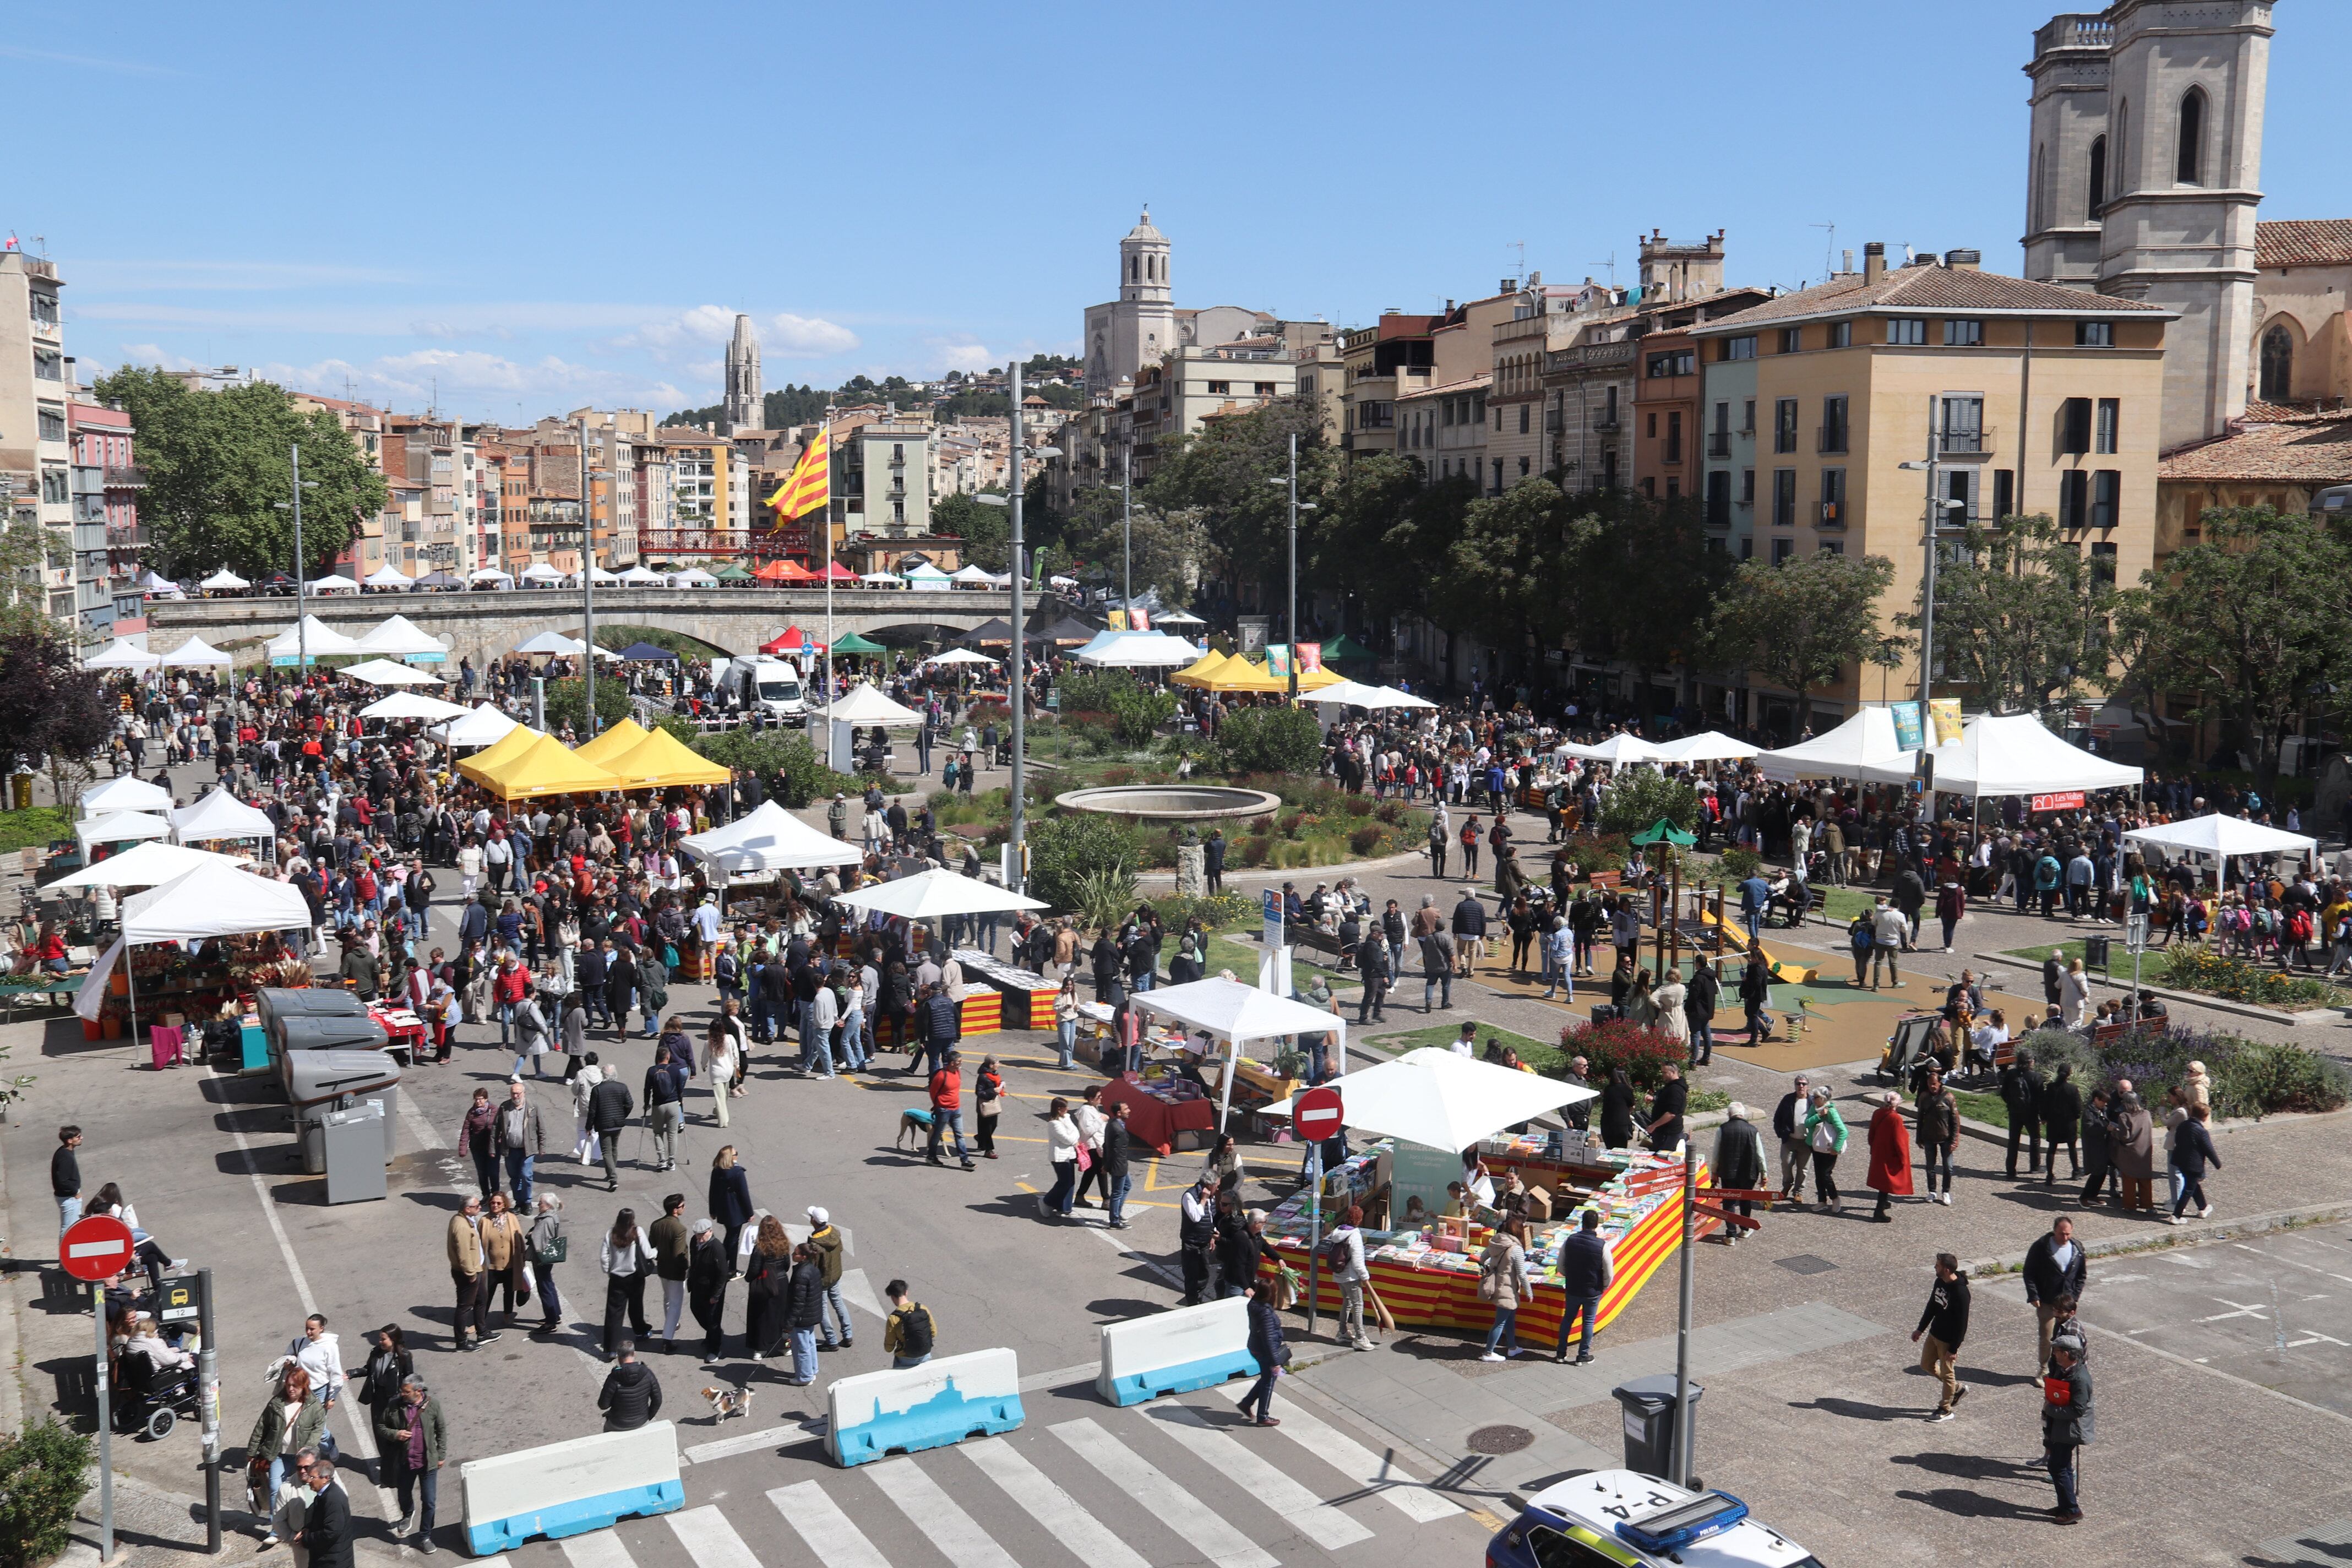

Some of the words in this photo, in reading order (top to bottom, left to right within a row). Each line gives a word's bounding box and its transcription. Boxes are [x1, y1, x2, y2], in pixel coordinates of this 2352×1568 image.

[2055, 793, 2066, 802] Les
[2066, 792, 2083, 801] Voltes
[1265, 892, 1271, 905] P
[1650, 1183, 1663, 1191] Estació
[1663, 1180, 1684, 1189] d'autobusos
[1600, 1491, 1674, 1520] P-4
[1700, 1524, 1719, 1536] POLICIA
